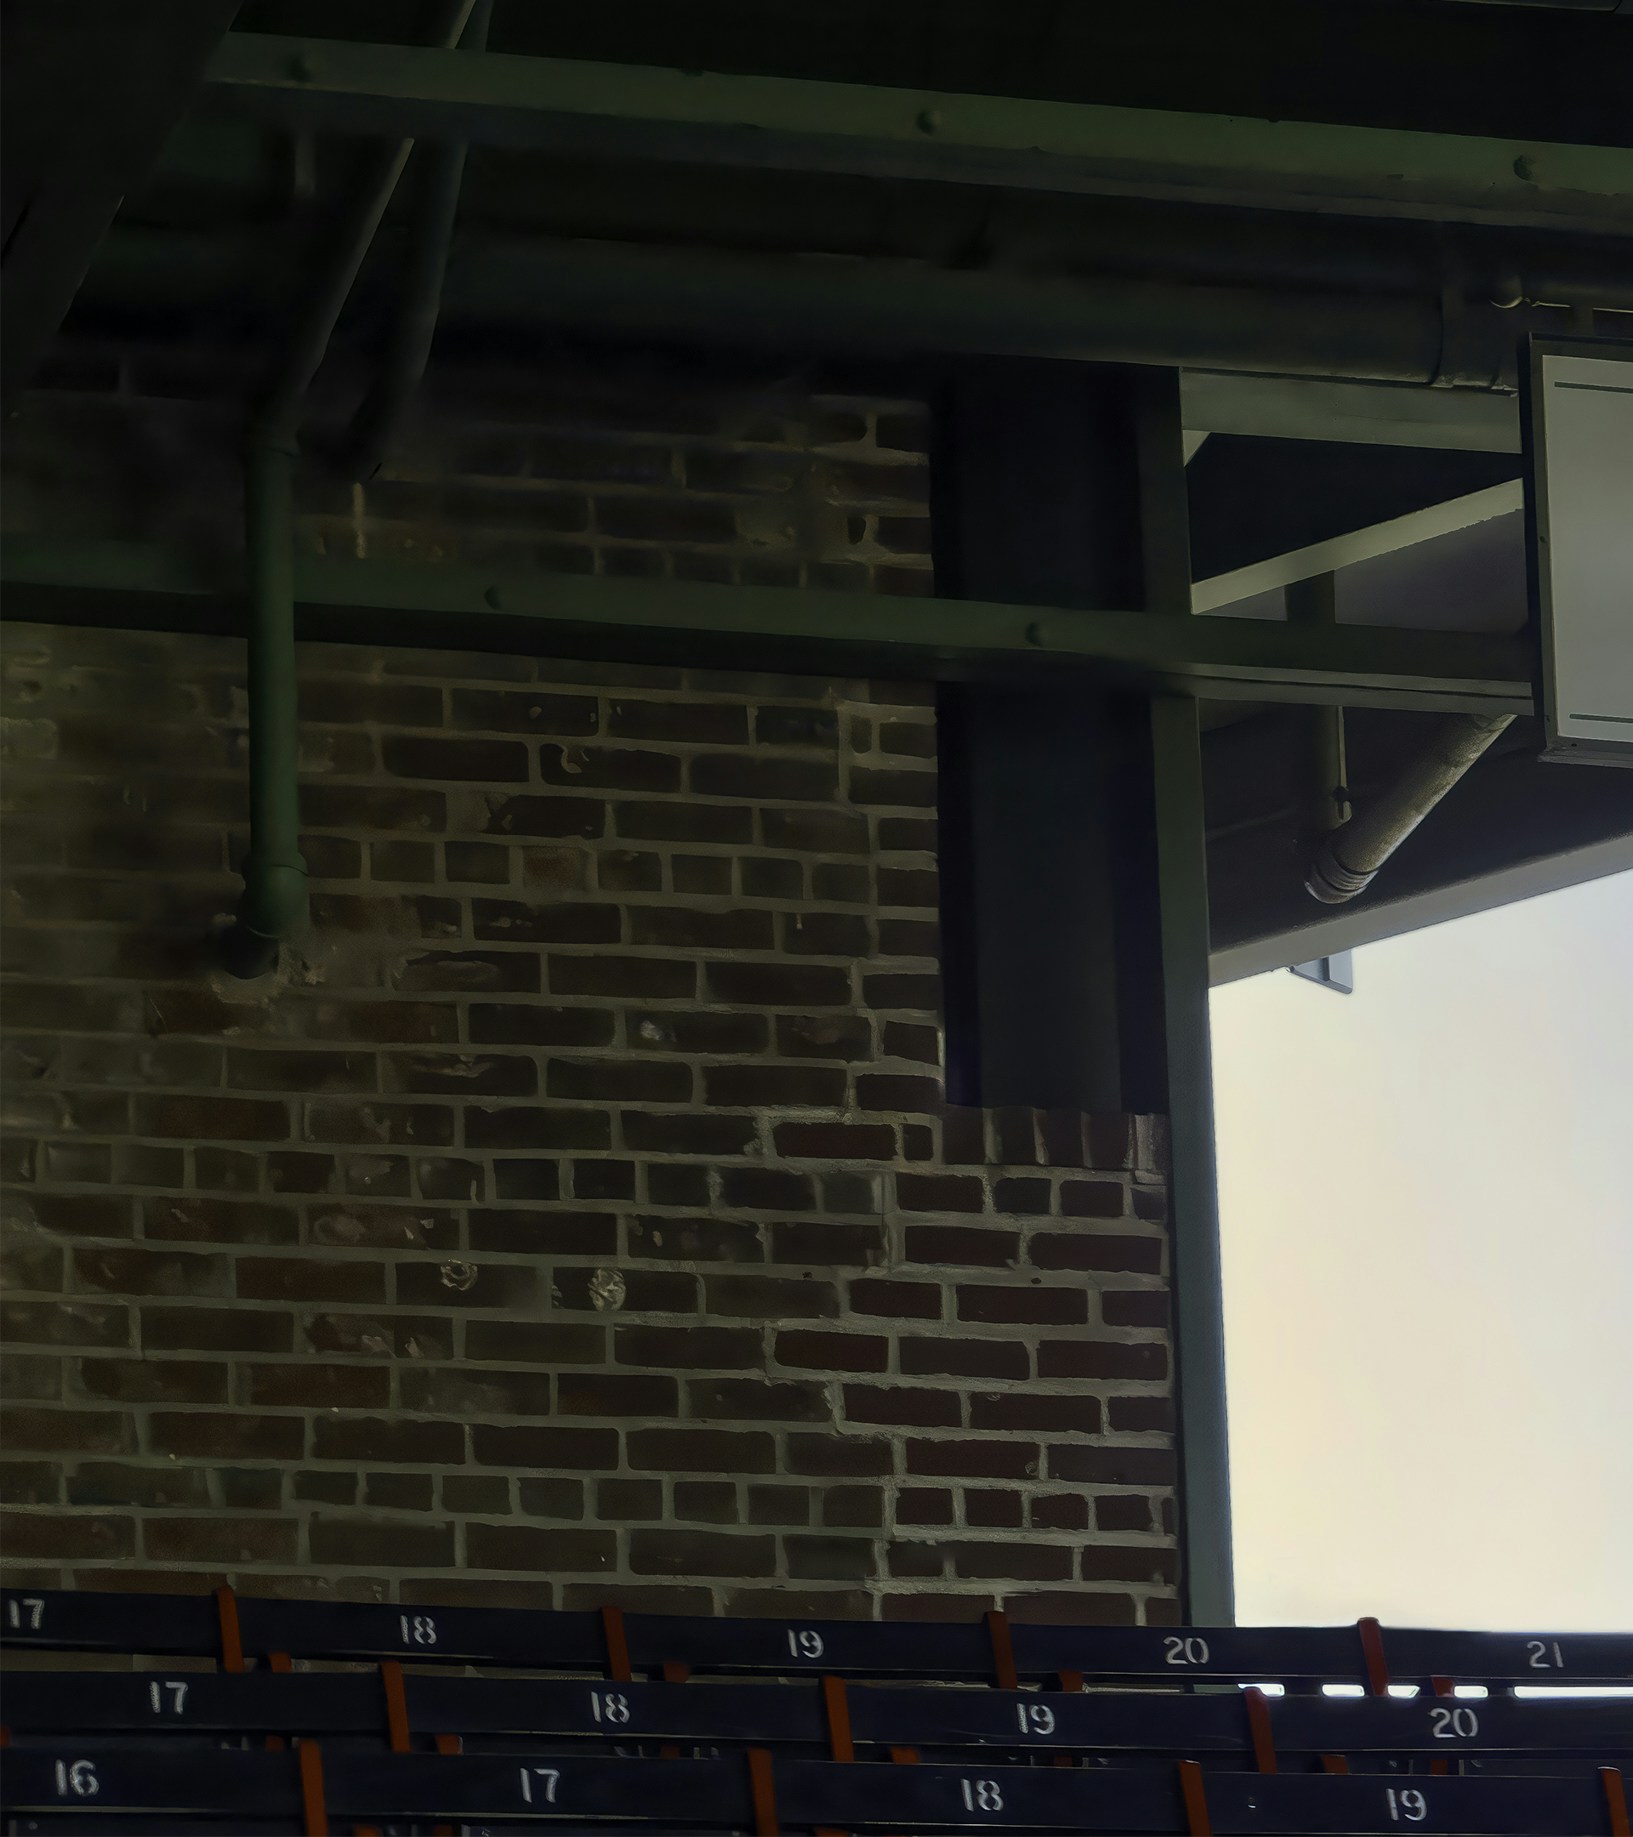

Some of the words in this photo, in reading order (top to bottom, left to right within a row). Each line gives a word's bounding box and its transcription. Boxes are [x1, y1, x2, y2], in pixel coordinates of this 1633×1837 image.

[9, 1598, 45, 1629] 17
[400, 1615, 437, 1645] 18
[788, 1629, 824, 1659] 19
[1163, 1636, 1209, 1665] 20
[1527, 1639, 1565, 1669] 21
[149, 1681, 189, 1714] 17
[591, 1691, 630, 1723] 18
[1016, 1703, 1055, 1735] 19
[1429, 1707, 1478, 1739] 20
[55, 1759, 100, 1795] 16
[520, 1767, 560, 1803] 17
[962, 1778, 1004, 1812] 18
[1387, 1788, 1427, 1821] 19
